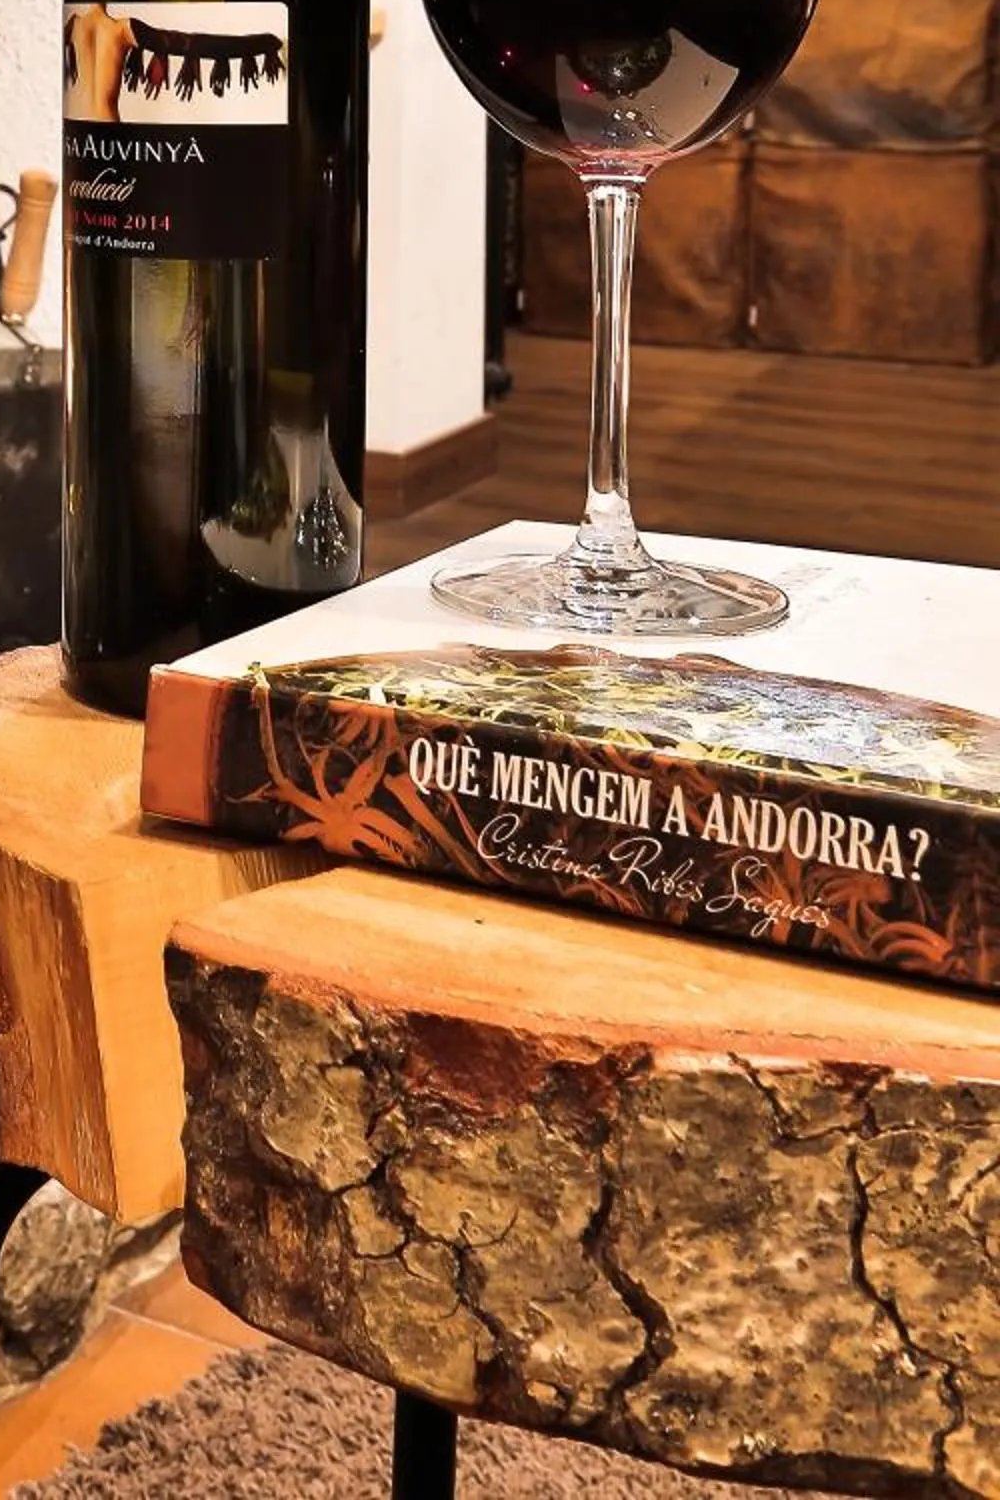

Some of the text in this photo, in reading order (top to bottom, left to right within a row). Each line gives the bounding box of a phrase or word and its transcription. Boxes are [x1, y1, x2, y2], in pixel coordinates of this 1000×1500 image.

[94, 234, 155, 251] d'Andorra
[123, 213, 172, 232] 2014
[409, 735, 930, 881] QUÈ MENGEM A ANDORRA?
[477, 812, 602, 881] Cristina
[608, 835, 705, 903] Ribes
